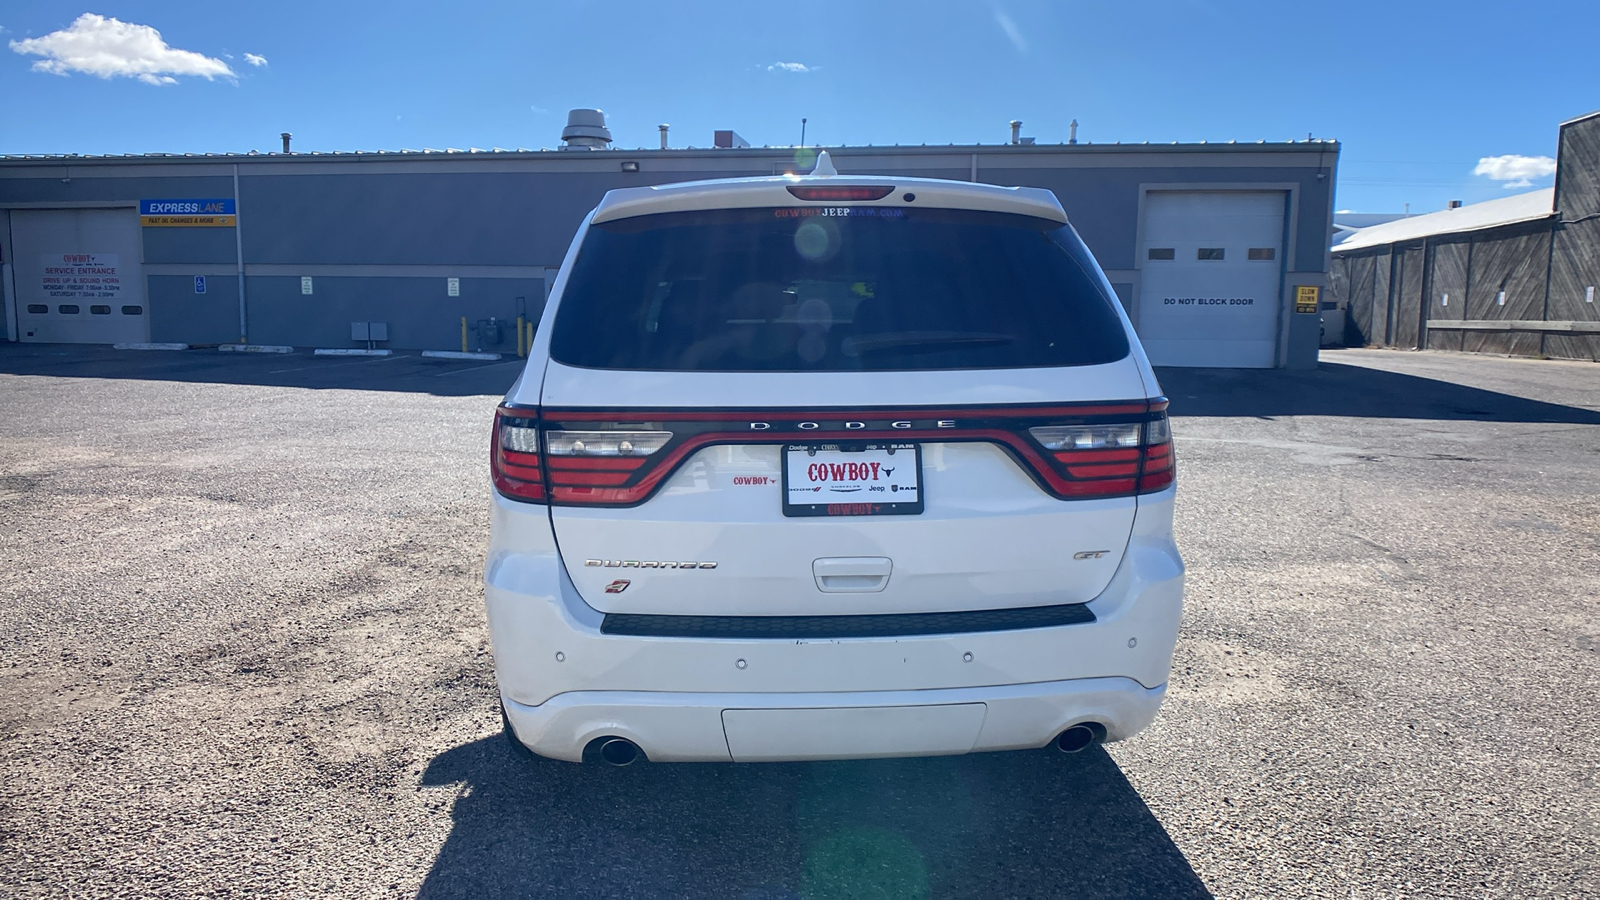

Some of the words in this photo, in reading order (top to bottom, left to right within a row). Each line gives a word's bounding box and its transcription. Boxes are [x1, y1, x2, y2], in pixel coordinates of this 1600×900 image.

[63, 254, 91, 263] COWBOY
[45, 267, 75, 275] SERVICE
[78, 267, 116, 275] ENTRANCE
[750, 420, 956, 429] DODGE
[788, 444, 809, 452] Dodge
[807, 461, 882, 482] COWBOY
[733, 476, 769, 485] COWBOY
[827, 502, 873, 516] COWBOY
[1073, 550, 1111, 560] GT
[584, 558, 719, 569] DURANGO
